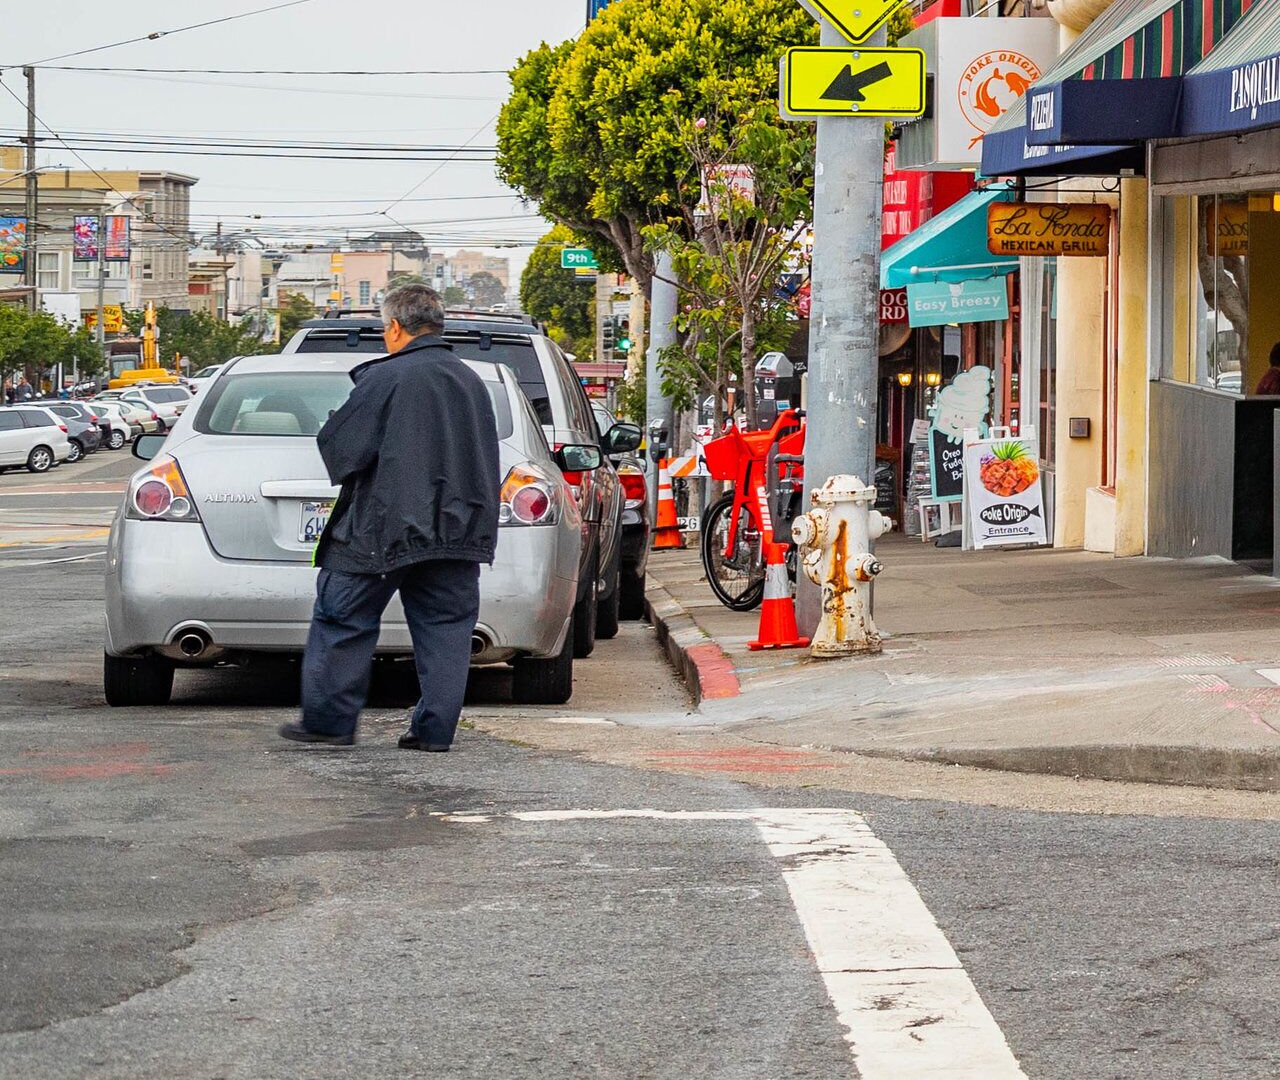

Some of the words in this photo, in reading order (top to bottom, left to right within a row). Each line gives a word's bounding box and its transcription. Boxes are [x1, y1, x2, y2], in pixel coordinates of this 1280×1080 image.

[965, 56, 993, 82] POKE
[990, 207, 1031, 237] La
[1001, 240, 1055, 251] MEXICAN
[1061, 240, 1099, 251] GRILL
[567, 253, 588, 264] 9th
[914, 300, 947, 312] Easy
[951, 295, 1001, 308] Breezy
[942, 449, 961, 461] Oreo
[204, 493, 257, 503] ALTIMA
[982, 507, 1002, 521] Poke
[1003, 504, 1028, 524] Origin
[988, 526, 1029, 535] Entrance
